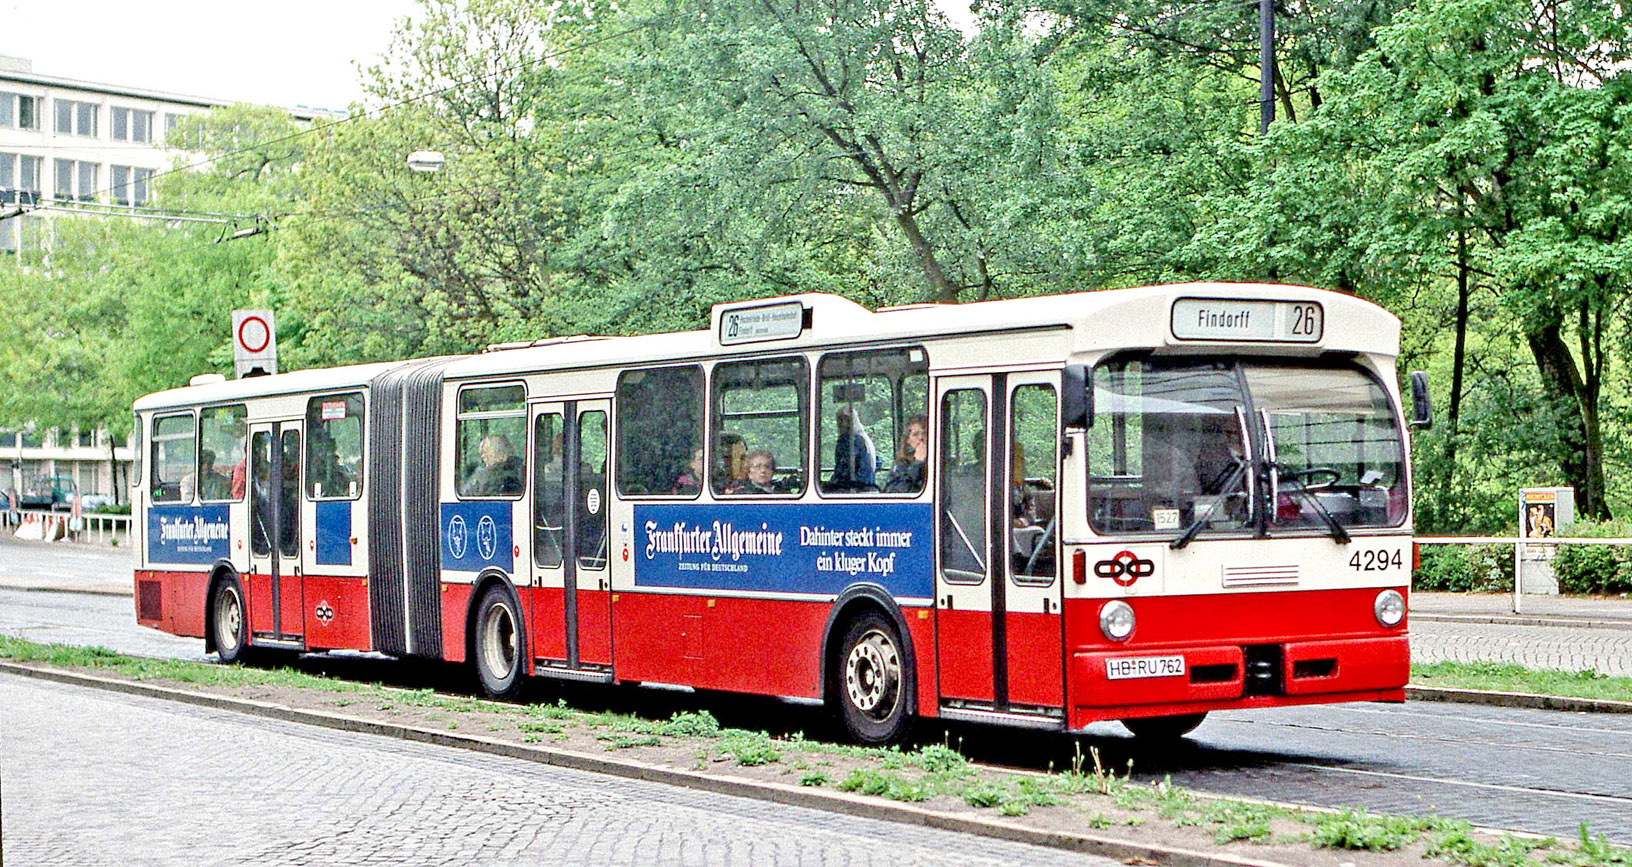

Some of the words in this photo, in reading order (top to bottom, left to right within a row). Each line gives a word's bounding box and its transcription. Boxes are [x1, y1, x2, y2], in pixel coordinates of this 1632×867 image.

[728, 314, 740, 337] 26
[1198, 309, 1250, 329] Findorff
[1292, 305, 1315, 335] 26
[1156, 511, 1178, 524] 1527
[645, 520, 712, 560] Frankfurter
[711, 520, 783, 561] Allgemeine
[800, 526, 845, 546] Dahinter
[844, 526, 874, 547] steckt
[875, 526, 912, 547] immer
[678, 562, 700, 571] ZEITUNG
[711, 562, 749, 573] DEUTSCHLAND
[816, 550, 833, 571] ein
[834, 551, 867, 576] kluger
[867, 551, 896, 577] Kopf
[1349, 549, 1403, 571] 4294
